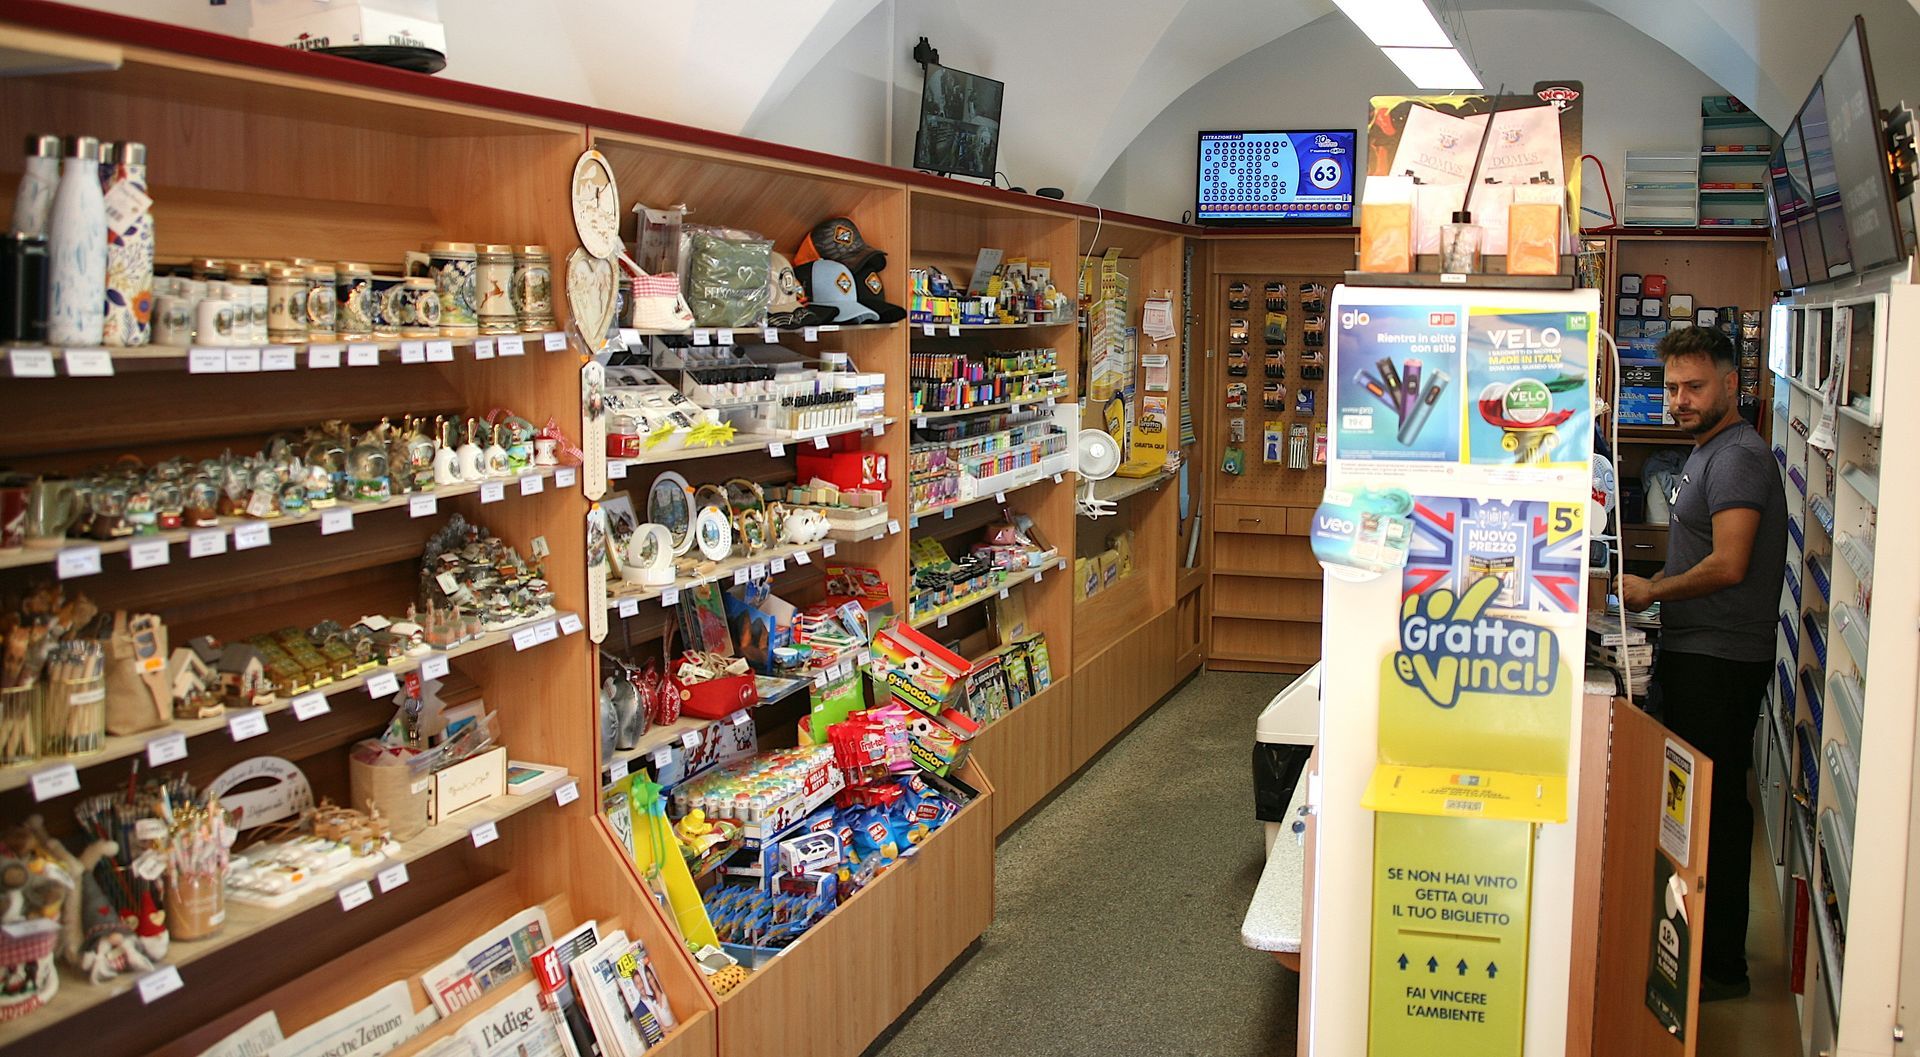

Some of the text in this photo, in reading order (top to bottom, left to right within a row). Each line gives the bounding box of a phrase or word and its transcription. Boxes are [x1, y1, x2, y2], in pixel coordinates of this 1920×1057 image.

[1537, 89, 1580, 101] WOW
[1314, 166, 1337, 182] 63
[1341, 309, 1370, 330] glo
[1377, 332, 1416, 344] Rientra
[1418, 332, 1428, 344] in
[1487, 327, 1561, 350] VELO
[1410, 343, 1457, 354] con stile
[1488, 353, 1562, 365] MADE IN ITALY
[1626, 371, 1652, 380] OCB
[1509, 390, 1546, 402] VELO
[1320, 515, 1354, 534] veo
[1469, 529, 1518, 543] NUOVO
[1468, 541, 1517, 553] PREZZO
[1404, 615, 1535, 658] Gratta
[1399, 655, 1414, 680] e
[809, 769, 825, 784] HELLO
[811, 777, 826, 792] KITTY
[1387, 867, 1518, 890] SE NON HAI VINTO
[1415, 887, 1488, 906] GETTA QUI
[1392, 905, 1510, 926] IL TUO BIGLIETTO
[445, 975, 483, 1013] Bild
[1405, 986, 1488, 1006] FAI VINCERE
[1406, 1003, 1485, 1024] L'AMBIENTE
[481, 1004, 535, 1050] l'Adige
